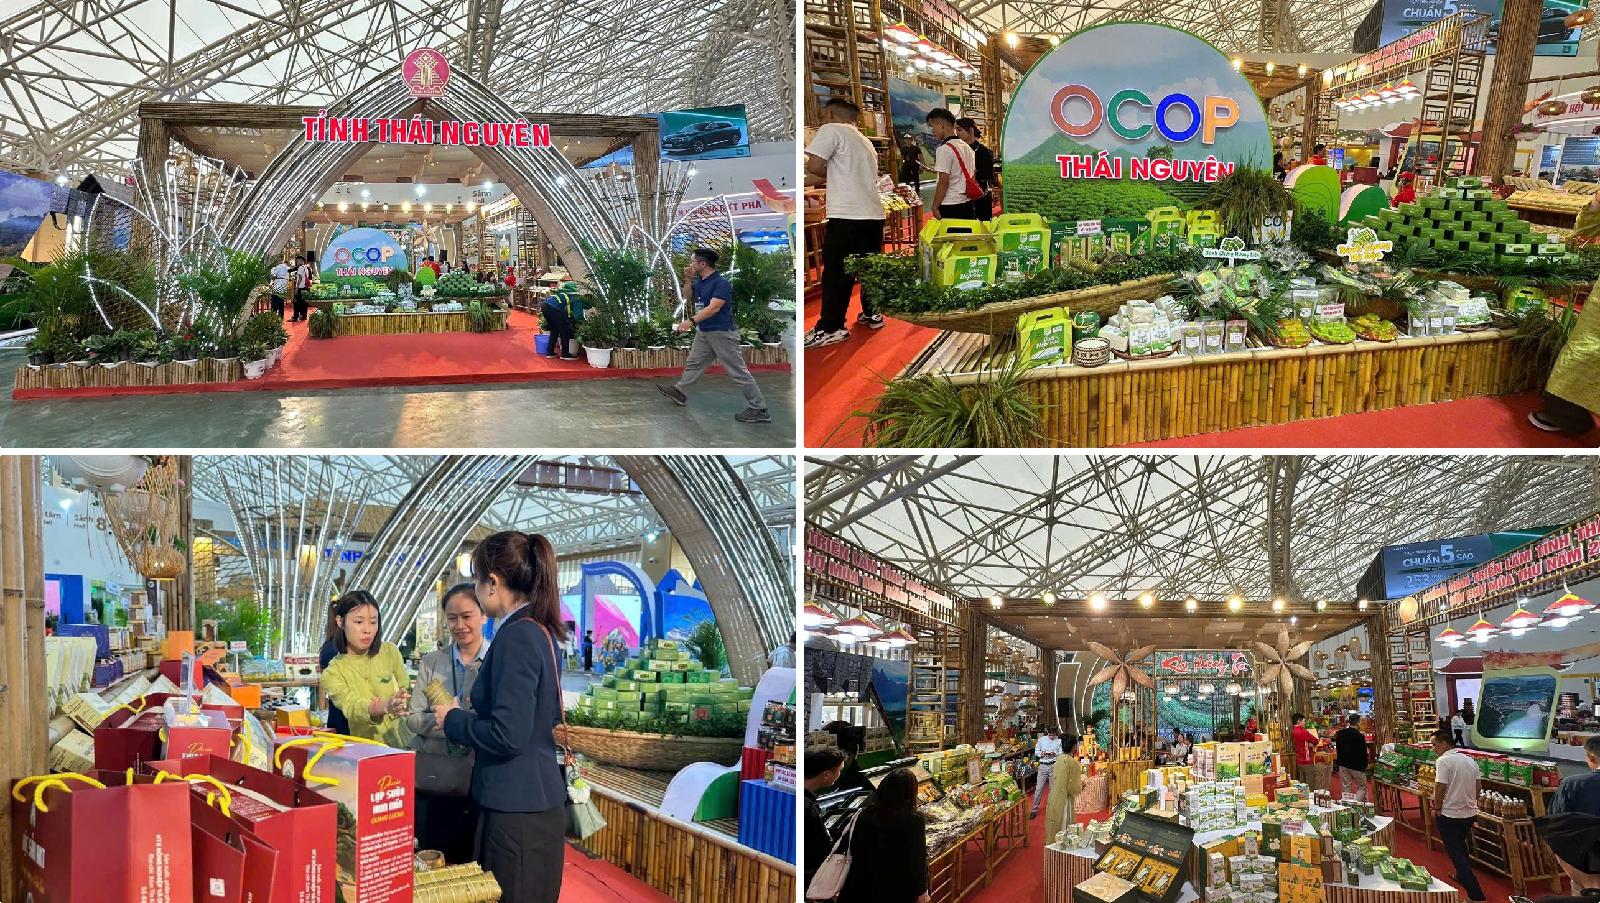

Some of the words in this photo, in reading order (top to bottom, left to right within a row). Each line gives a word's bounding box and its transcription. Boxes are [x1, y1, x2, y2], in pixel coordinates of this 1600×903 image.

[1402, 4, 1442, 18] CHUẨN
[302, 109, 369, 143] TỈNH
[375, 113, 434, 145] THÁI
[441, 118, 551, 148] NGUYÊN
[1050, 84, 1240, 144] OCOP
[1056, 150, 1122, 180] THÁI
[1130, 155, 1235, 183] NGUYÊN
[335, 247, 395, 264] OCOP
[807, 529, 850, 563] TRIỂN
[1402, 553, 1440, 567] CHUẨN
[1440, 544, 1455, 564] 5
[1456, 552, 1474, 561] SAO
[1472, 561, 1503, 584] TRIỂN
[1504, 549, 1533, 571] LÃM
[1535, 532, 1571, 559] TỈNH
[1576, 520, 1600, 542] TH
[1487, 572, 1516, 592] MÙA
[1517, 561, 1543, 583] THU
[1546, 549, 1585, 573] NĂM
[1588, 540, 1600, 557] 2
